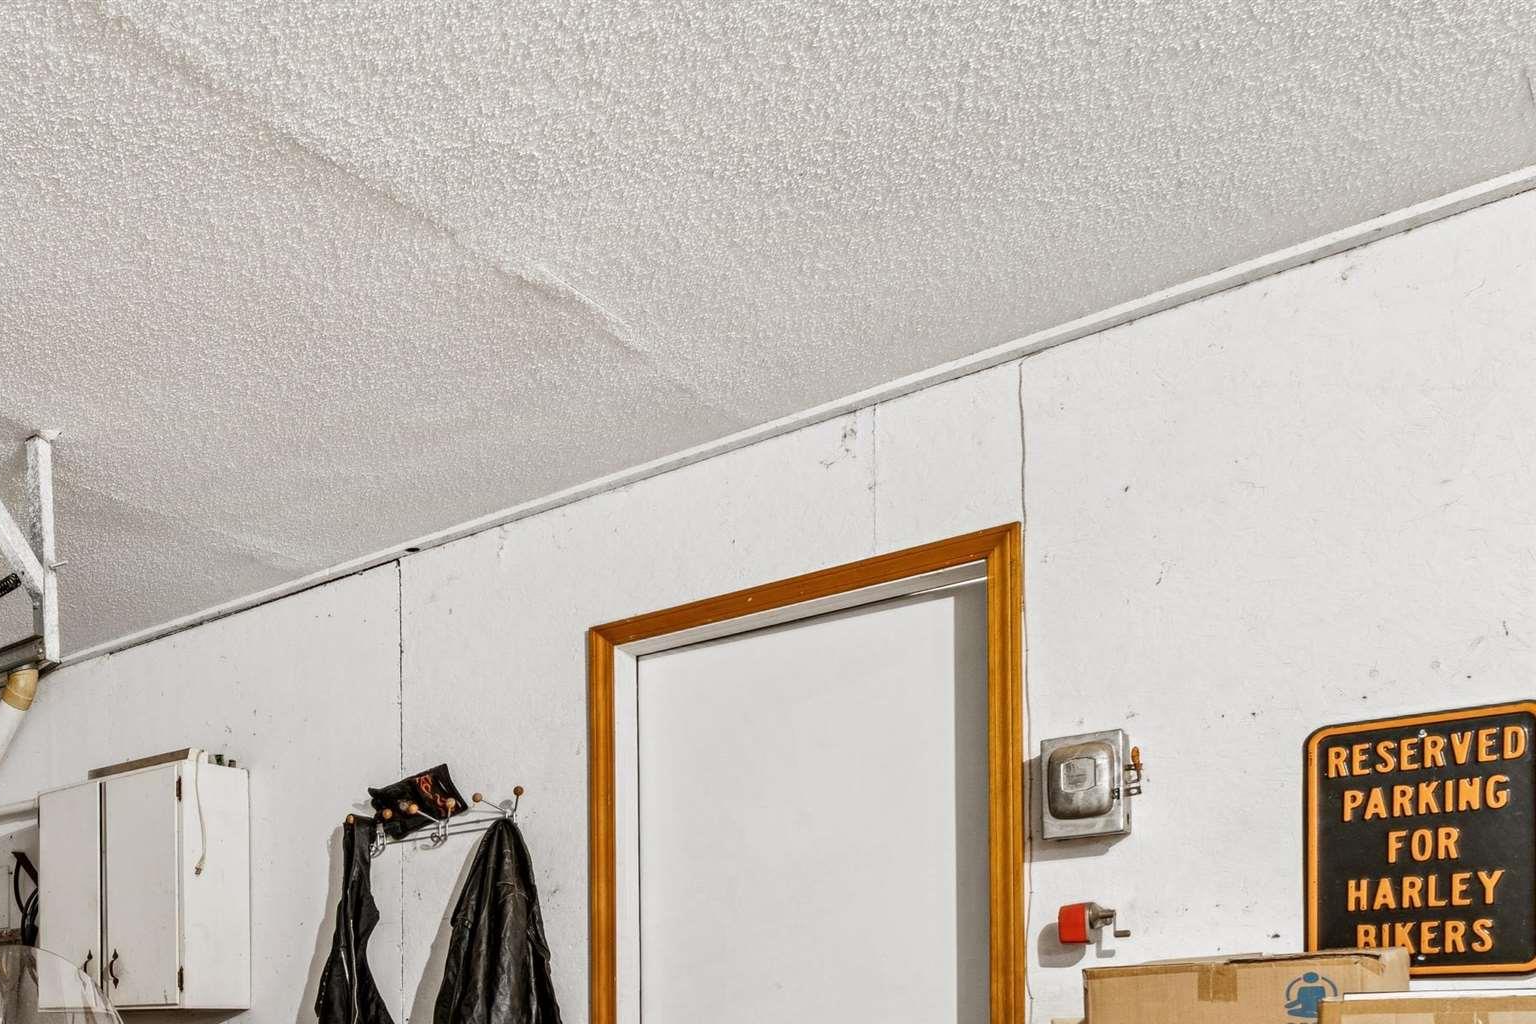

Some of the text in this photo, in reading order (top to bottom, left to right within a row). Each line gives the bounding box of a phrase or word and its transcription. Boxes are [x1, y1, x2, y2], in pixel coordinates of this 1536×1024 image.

[1327, 726, 1528, 778] RESERVED
[1343, 774, 1511, 822] PARKING
[1388, 826, 1460, 864] FOR
[1347, 868, 1506, 912] HARLEY
[1356, 918, 1494, 954] BIKERS
